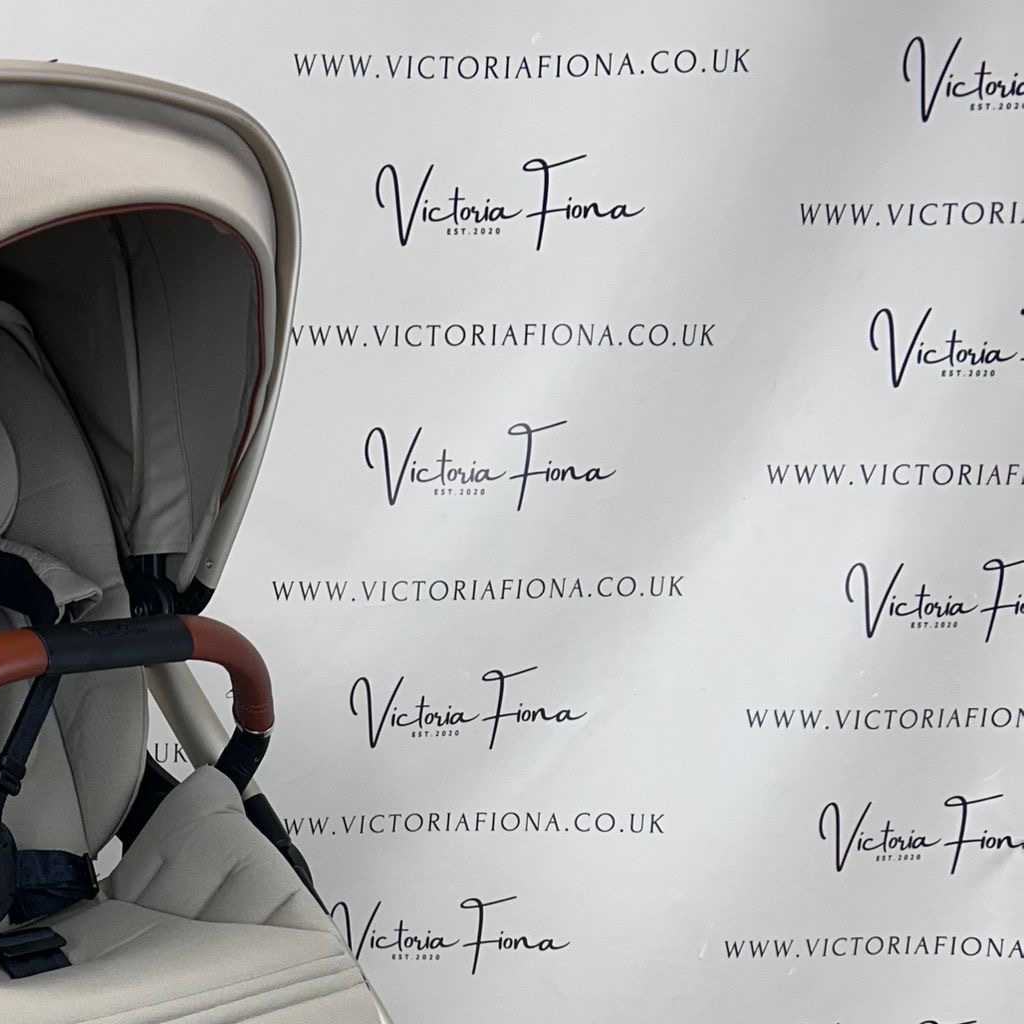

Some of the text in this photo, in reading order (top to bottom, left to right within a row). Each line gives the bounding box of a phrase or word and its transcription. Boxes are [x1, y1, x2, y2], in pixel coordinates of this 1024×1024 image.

[294, 49, 749, 79] WWW.VICTORIAFIONA.CO.UK
[374, 153, 645, 252] Victoria Fiona
[801, 202, 1024, 226] WWW.VICTORI
[446, 227, 501, 236] EST.2020
[869, 307, 1018, 389] Victoria
[941, 369, 996, 378] EST.2020
[364, 419, 618, 512] Victoria Fiona
[767, 464, 1024, 485] WWW.VICTORIAF
[433, 488, 486, 496] EST.2020
[272, 576, 683, 601] WWW.VICTORIAFIONA.CO.UK
[844, 561, 979, 640] Victoria
[910, 621, 958, 629] EST.2020
[348, 665, 588, 751] Victoria Fiona
[410, 730, 461, 740] EST.2020
[818, 793, 1024, 876] Victoria Fion
[874, 852, 923, 863] EST.2020
[330, 895, 571, 976] Victoria Fiona
[391, 953, 441, 961] EST.2020
